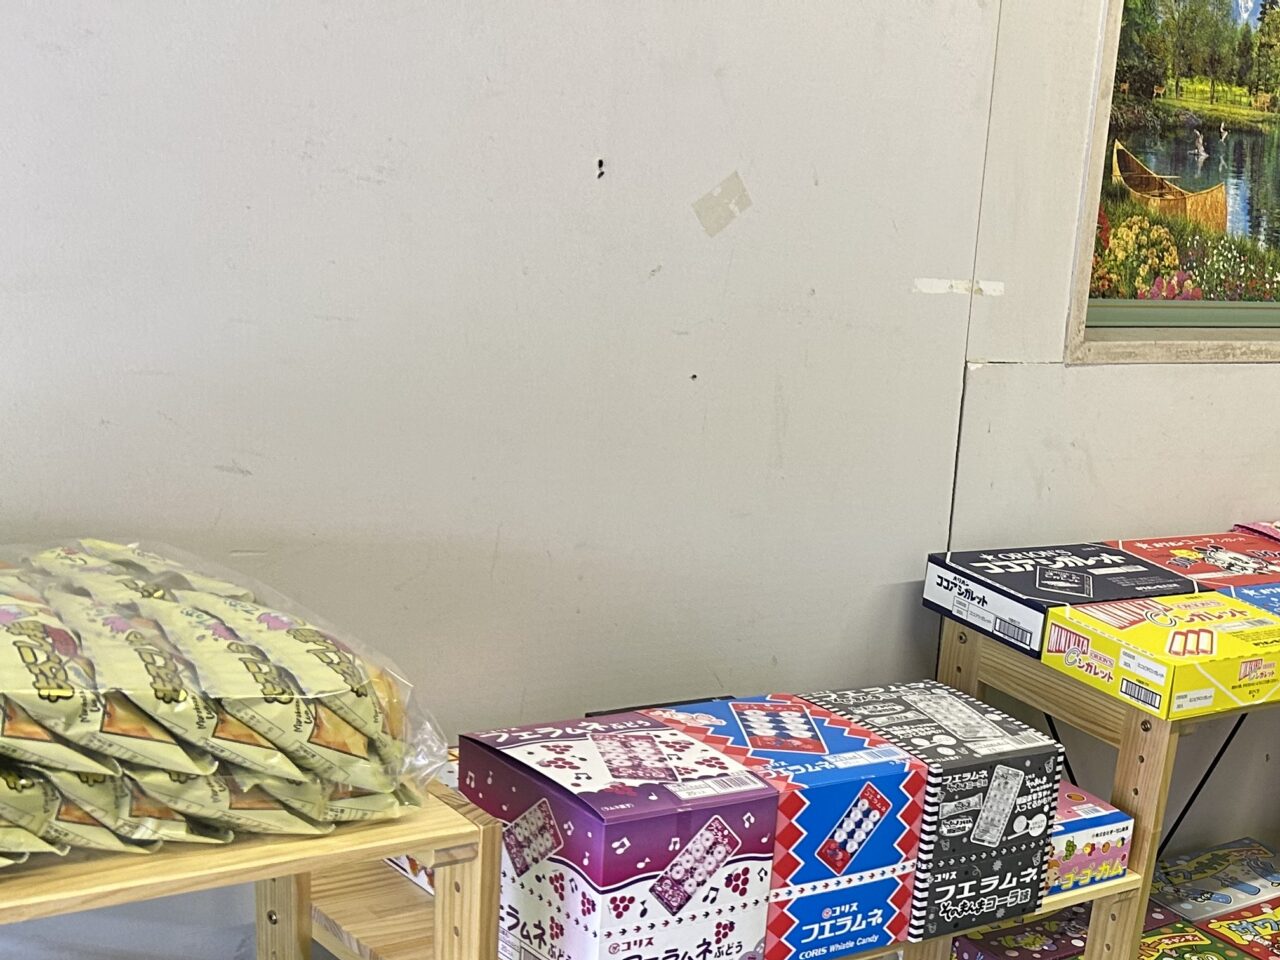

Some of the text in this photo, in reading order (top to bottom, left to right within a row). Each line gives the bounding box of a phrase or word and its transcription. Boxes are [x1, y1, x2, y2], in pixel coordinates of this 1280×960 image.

[968, 552, 1126, 575] ココアシガレット
[936, 574, 988, 607] ココアシガレット
[942, 770, 989, 785] フエラムネ
[934, 870, 958, 883] コリス
[934, 866, 1039, 904] フエラムネ
[831, 902, 859, 915] コリス
[800, 908, 883, 944] フエラムネ
[621, 937, 654, 951] コリス
[798, 933, 880, 960] CORIS Whistle Candy
